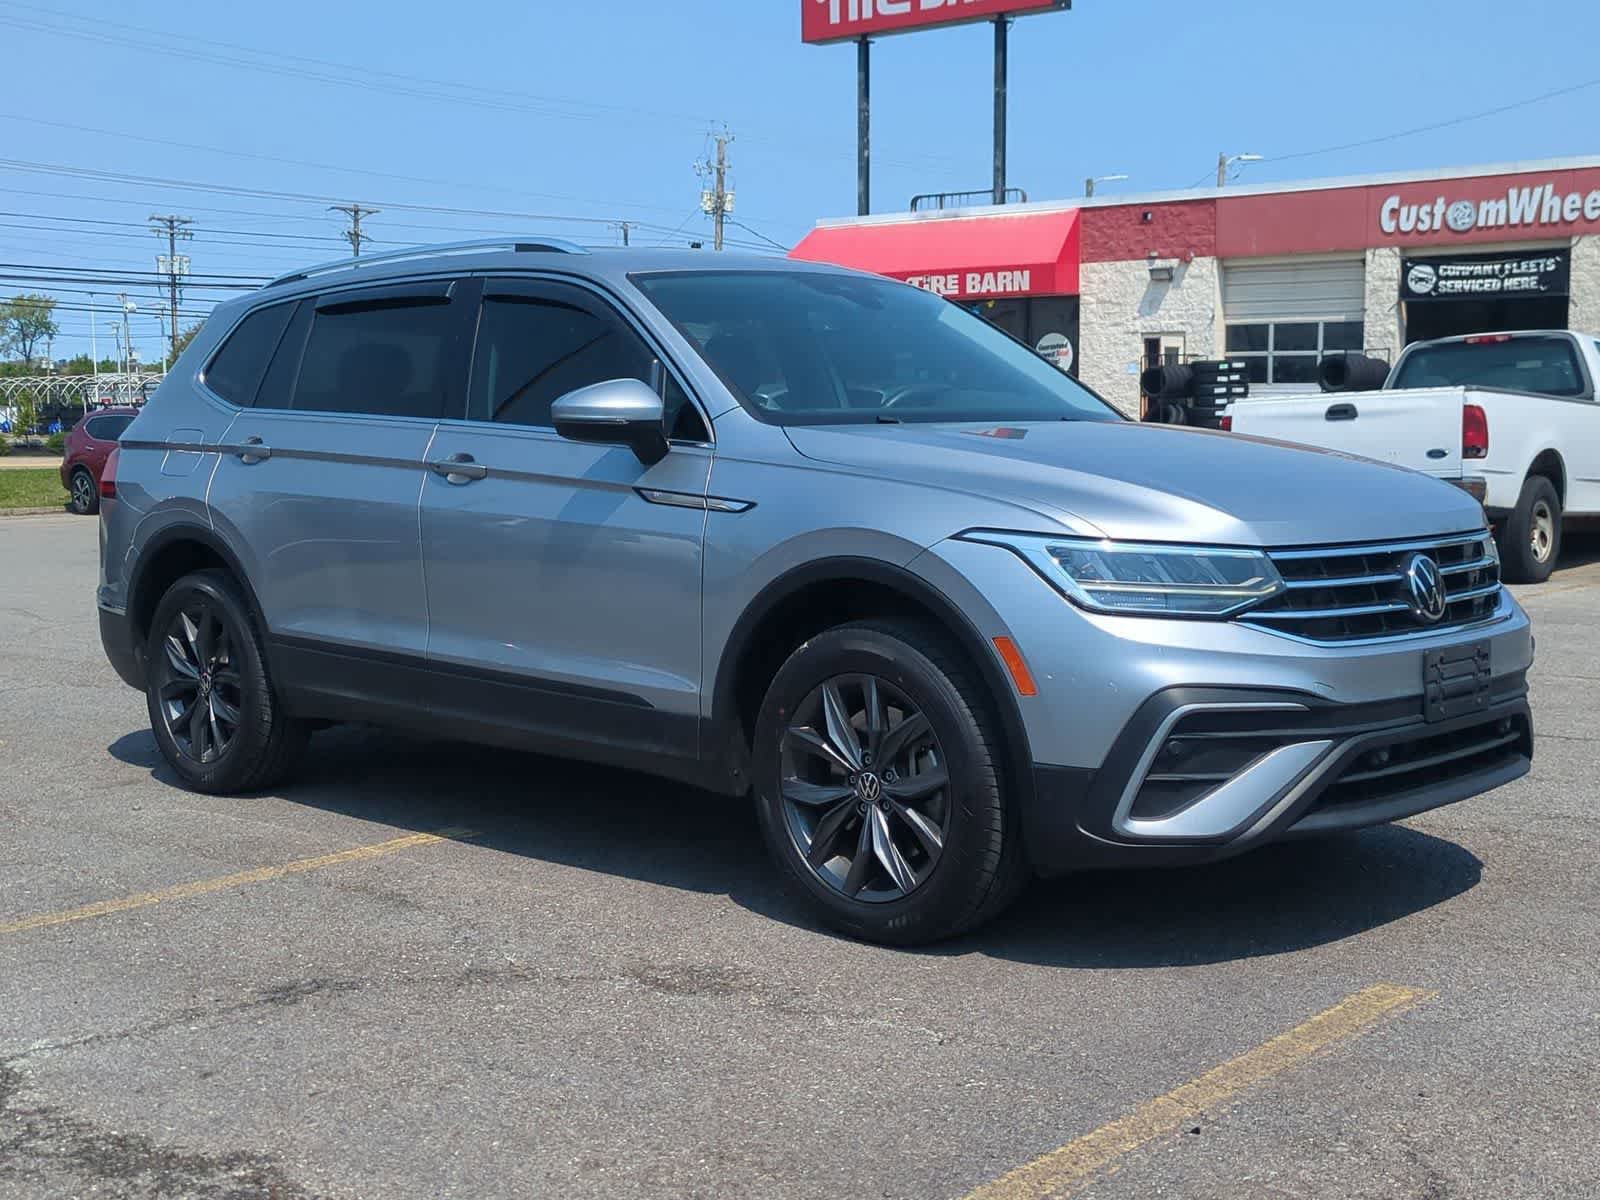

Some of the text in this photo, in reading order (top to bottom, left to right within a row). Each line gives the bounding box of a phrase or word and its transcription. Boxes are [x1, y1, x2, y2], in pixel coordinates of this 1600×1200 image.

[966, 270, 1031, 294] BARN
[1438, 276, 1539, 293] SERVICED HERE
